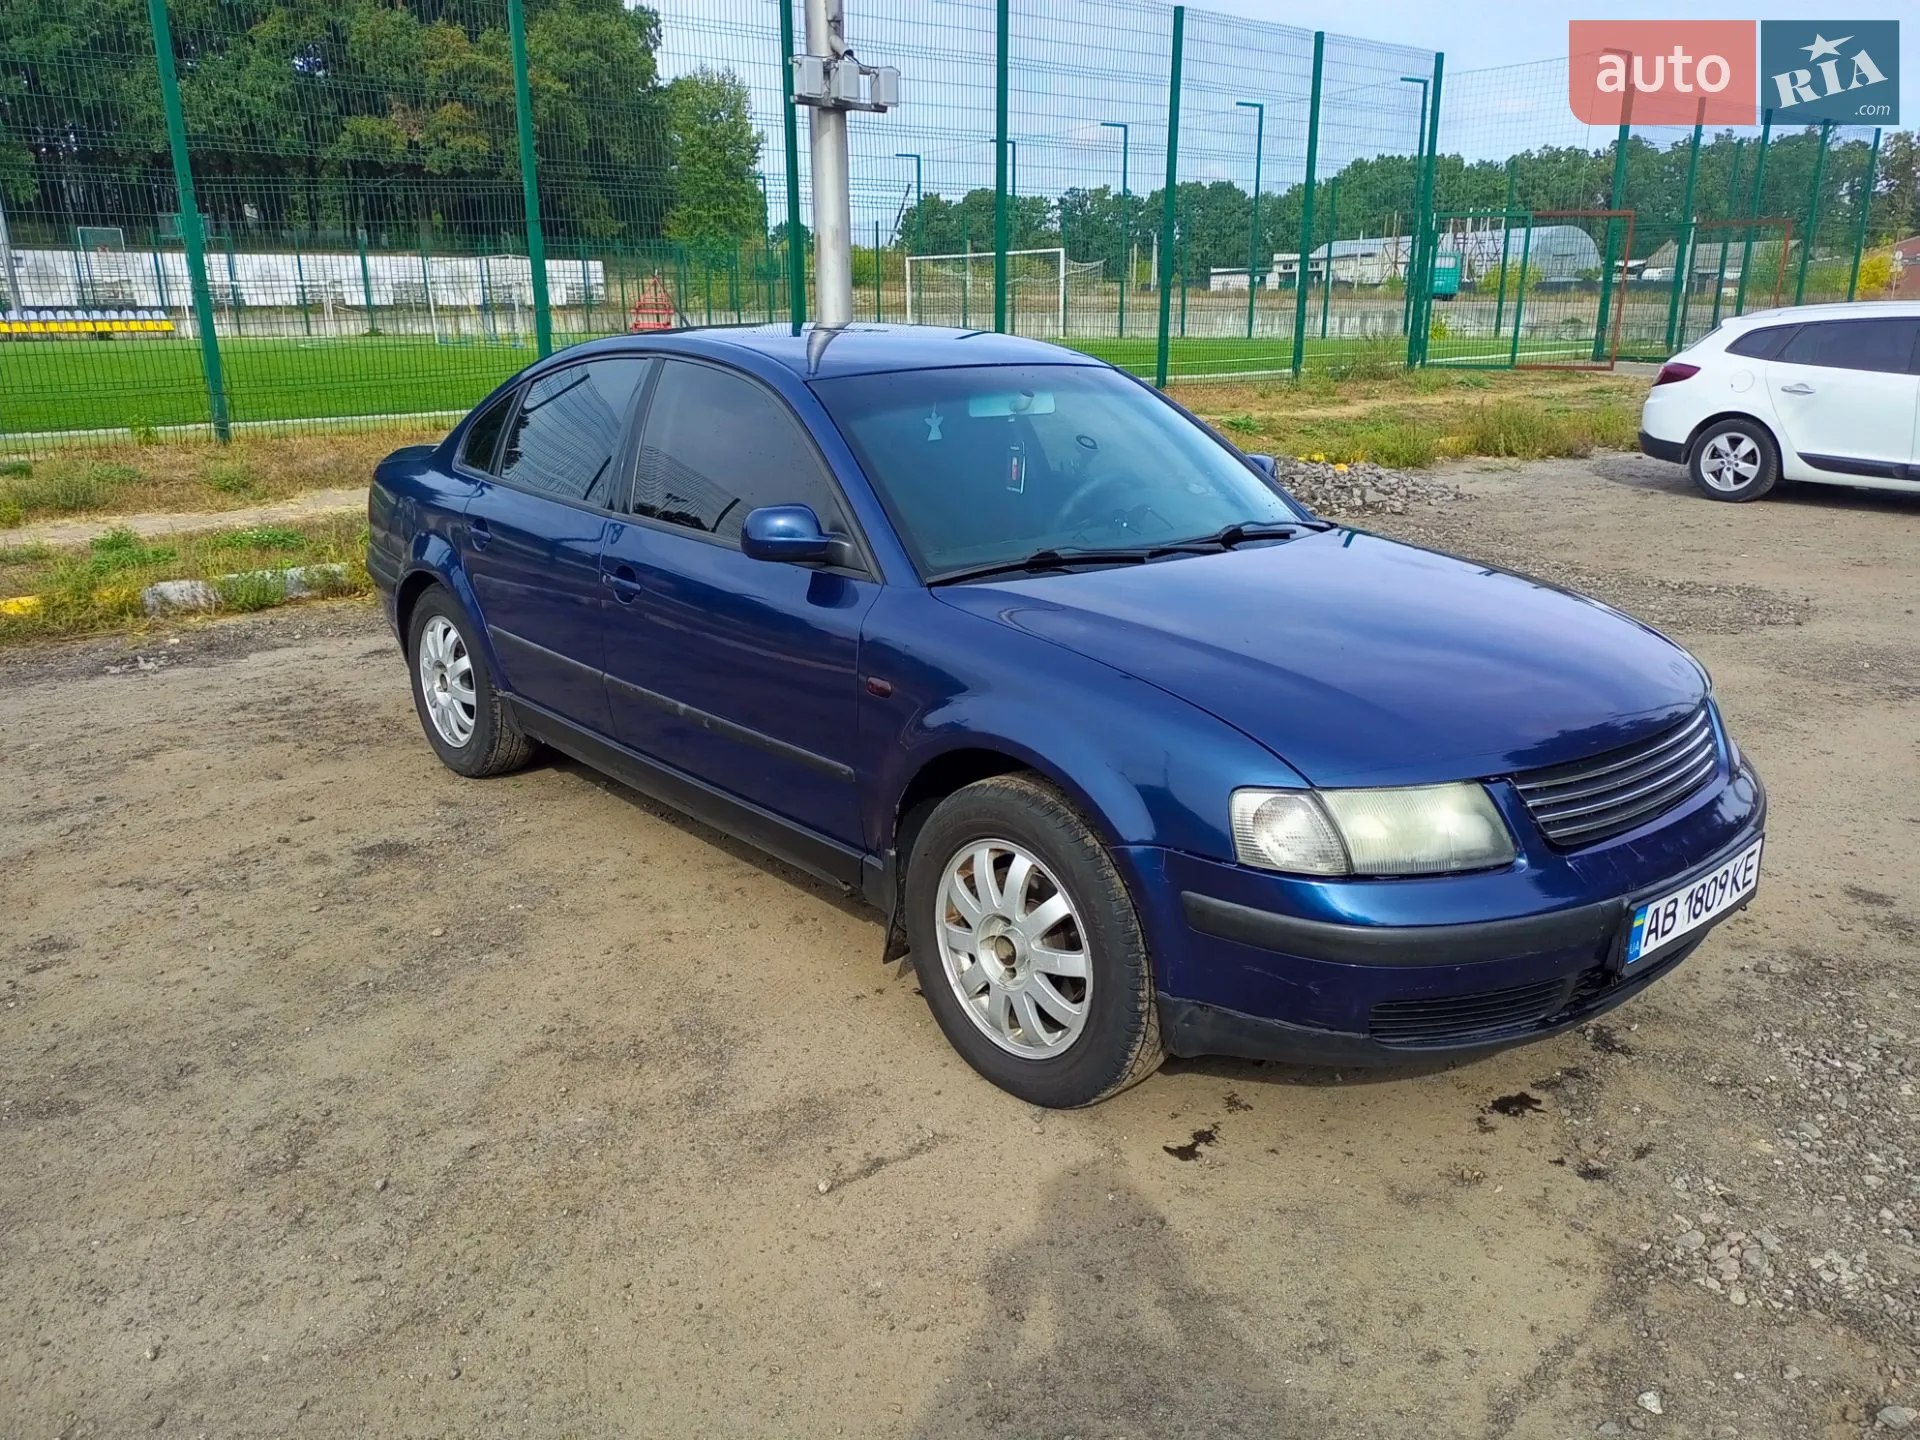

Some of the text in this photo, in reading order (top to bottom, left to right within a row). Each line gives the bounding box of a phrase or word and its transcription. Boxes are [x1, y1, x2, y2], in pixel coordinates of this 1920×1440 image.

[1643, 849, 1757, 948] AB 1809 KE
[1629, 940, 1640, 955] UA
